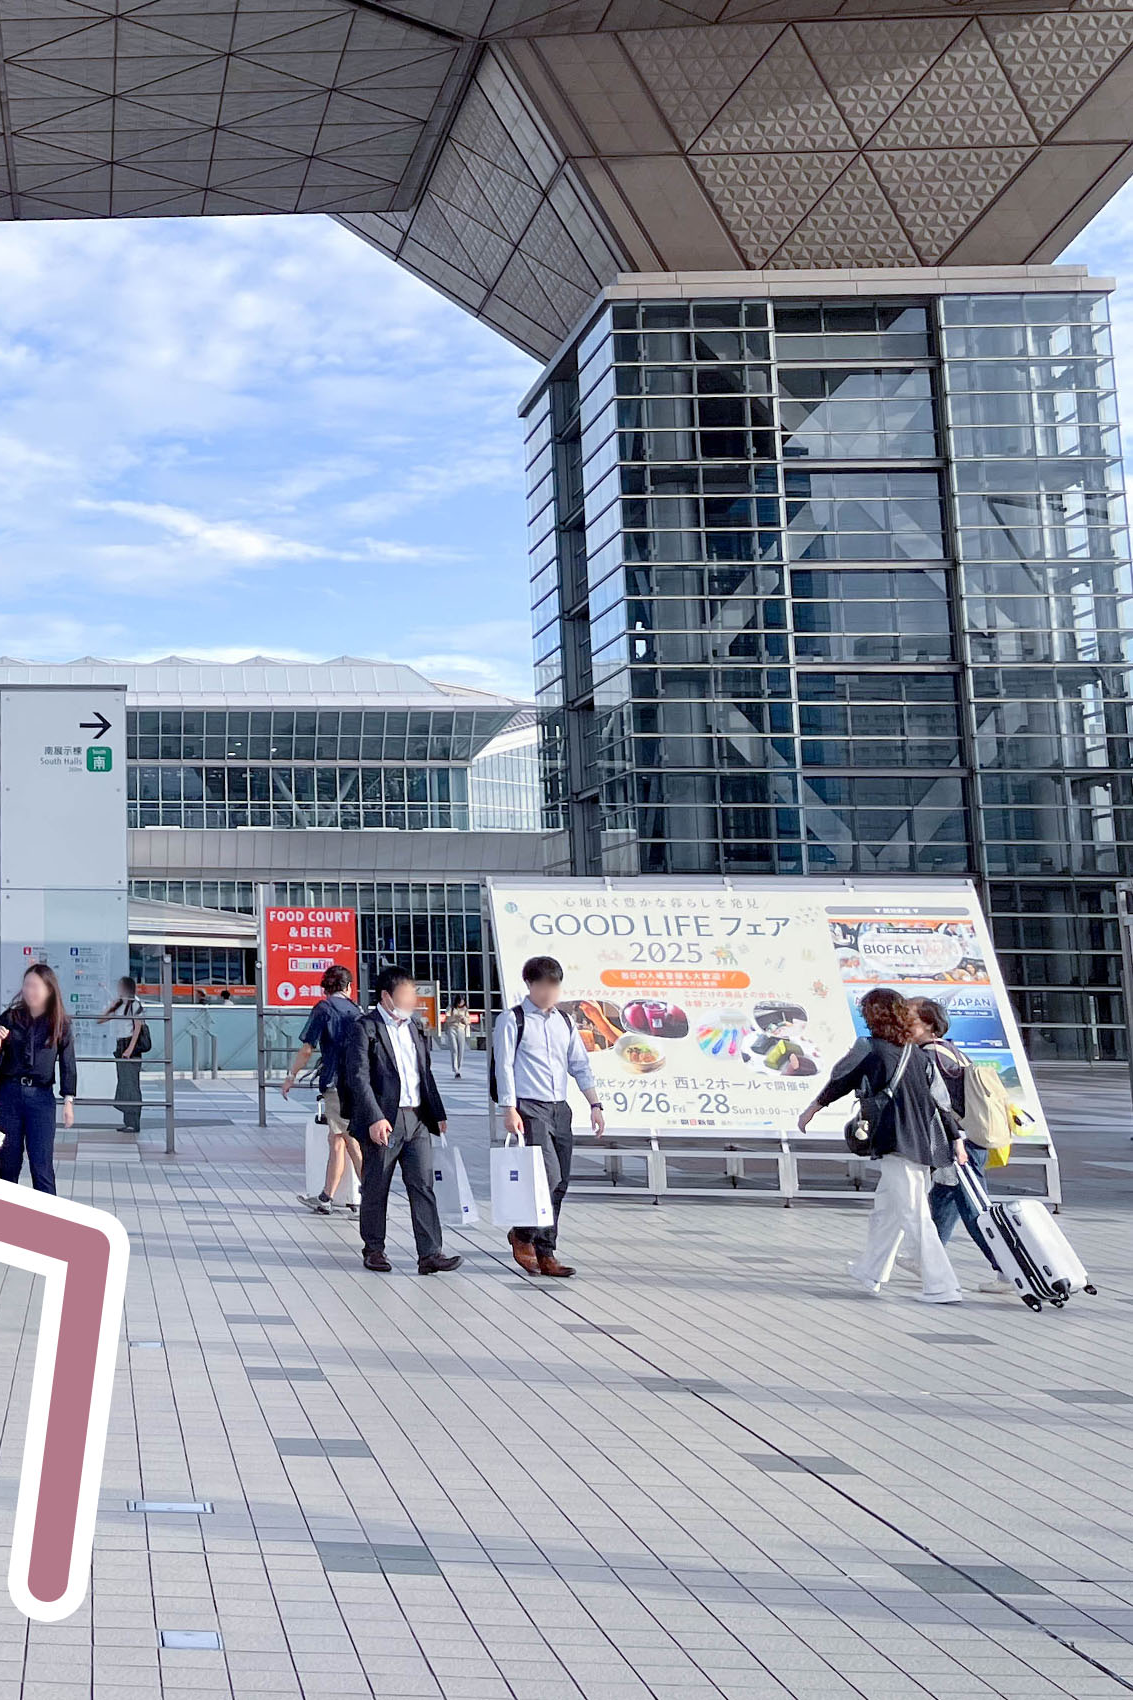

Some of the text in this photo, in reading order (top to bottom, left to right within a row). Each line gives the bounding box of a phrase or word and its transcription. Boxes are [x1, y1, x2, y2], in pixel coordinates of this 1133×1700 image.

[40, 757, 82, 765] South Halls
[93, 756, 106, 770] 南
[269, 911, 350, 922] FOOD COURT
[530, 913, 790, 937] GOOD LIFE フェア
[289, 927, 332, 937] & BEER
[629, 942, 703, 963] 2025
[863, 943, 921, 955] BIOFACH
[298, 984, 326, 997] 会議
[951, 998, 991, 1007] JAPAN
[596, 1079, 667, 1088] 京ビッグサイト
[613, 1092, 671, 1113] 9/26
[673, 1105, 686, 1113] Fri
[698, 1093, 730, 1114] 28
[732, 1105, 752, 1114] Sun
